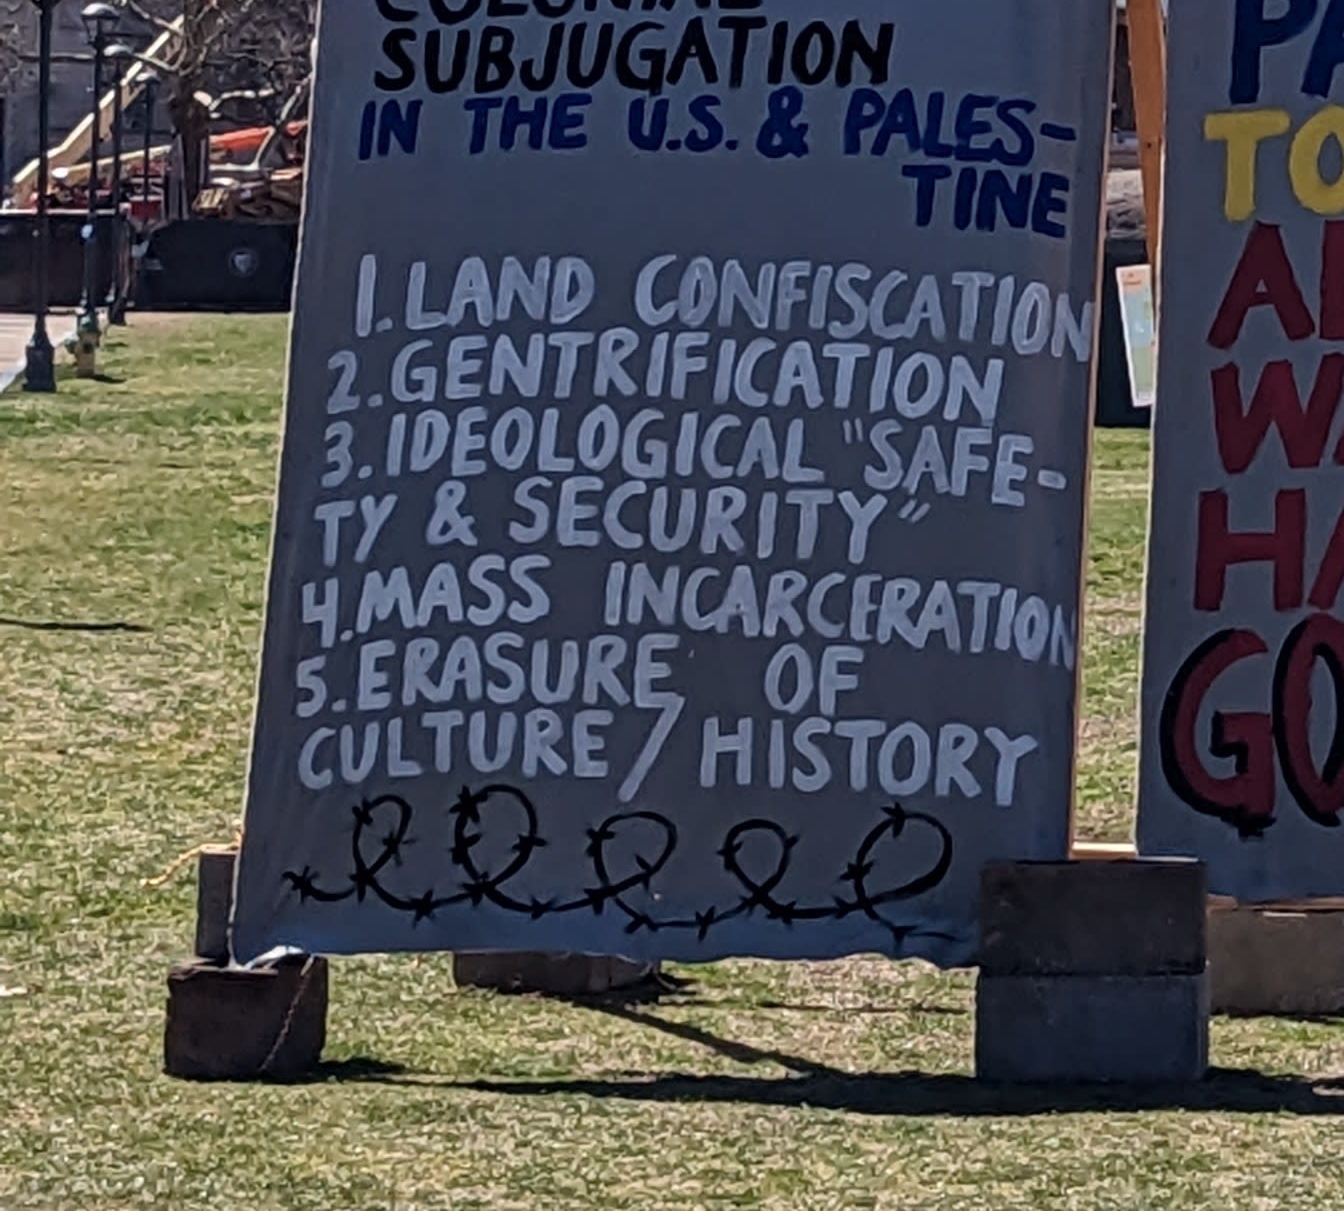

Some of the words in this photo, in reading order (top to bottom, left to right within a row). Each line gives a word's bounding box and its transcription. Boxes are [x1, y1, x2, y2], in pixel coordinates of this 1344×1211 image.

[374, 18, 895, 96] SUBJUGATION
[359, 99, 422, 161] IN
[464, 92, 592, 154] THE
[628, 94, 738, 154] U.S.
[755, 85, 809, 159] &
[843, 88, 1078, 166] PALES-
[901, 163, 1070, 238] TINE
[634, 254, 1095, 362] CONFISCATION
[313, 492, 399, 566] TY
[425, 479, 478, 548] &
[604, 560, 1076, 670] INCARCERATION
[764, 643, 864, 717] OF
